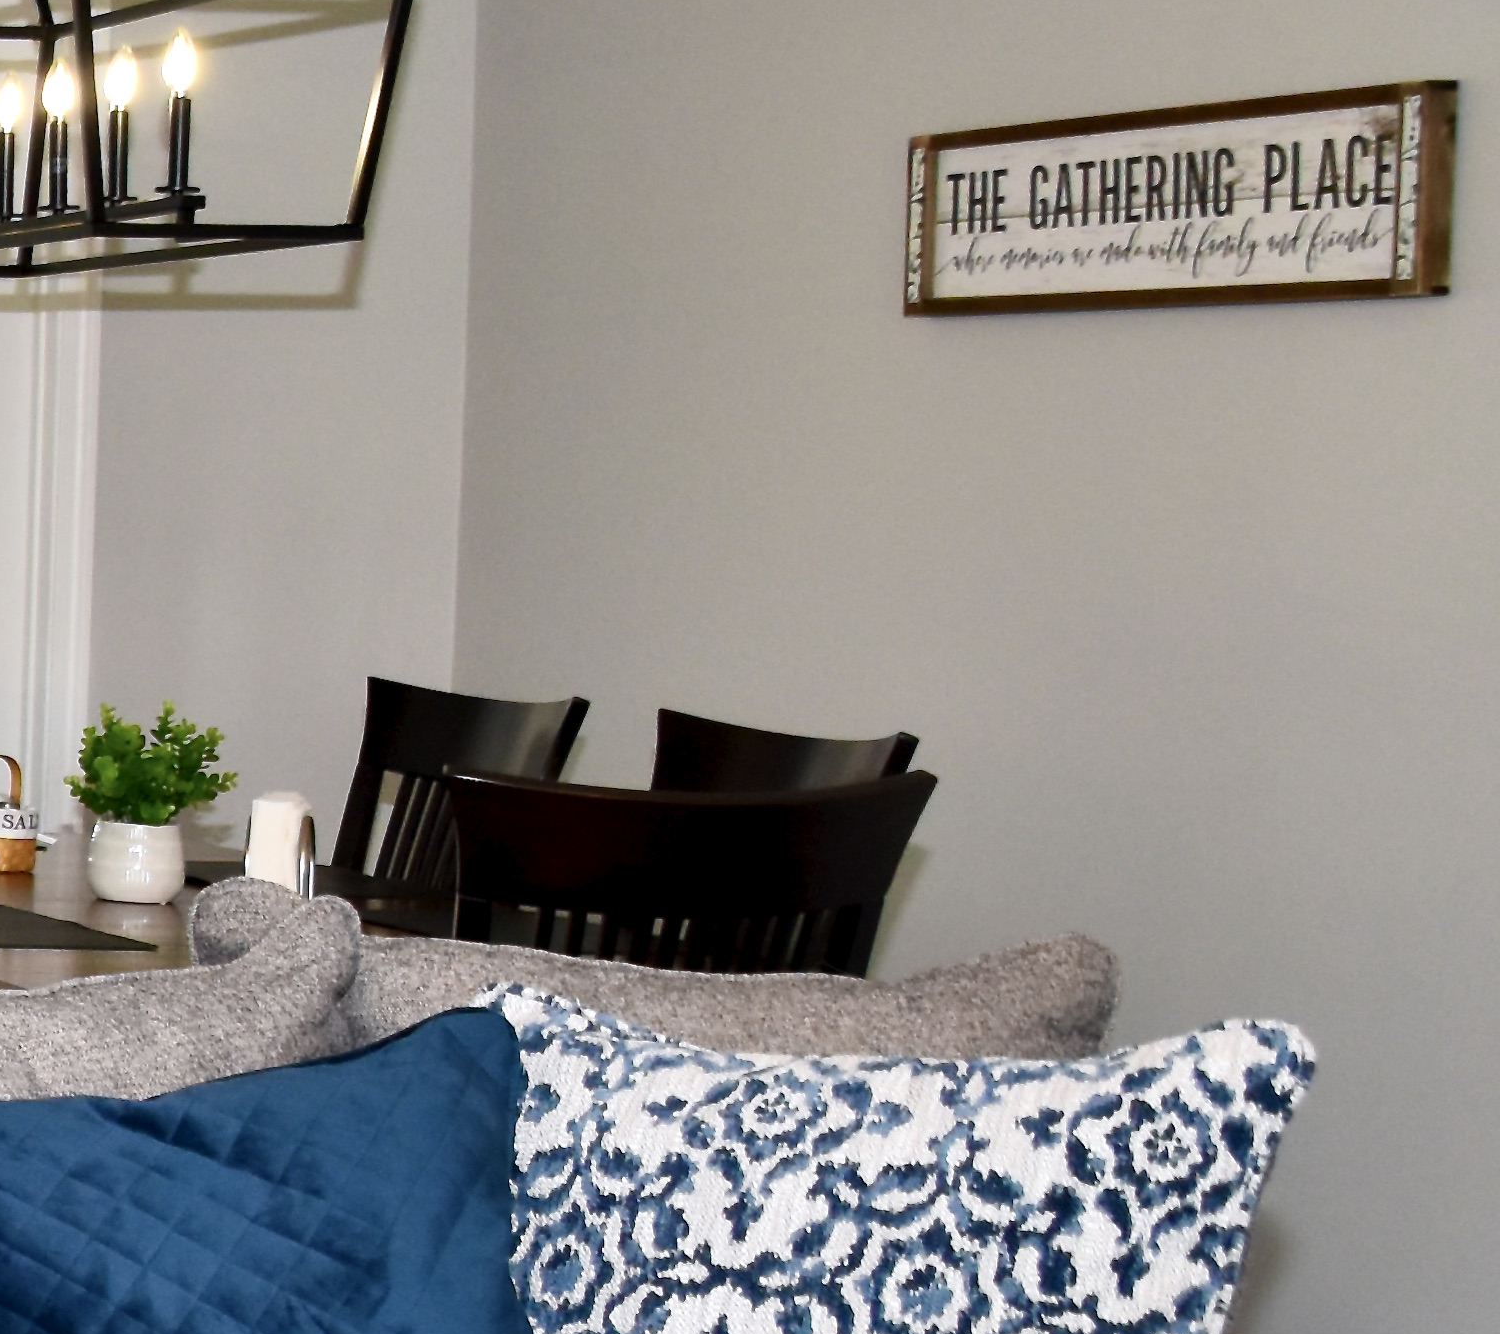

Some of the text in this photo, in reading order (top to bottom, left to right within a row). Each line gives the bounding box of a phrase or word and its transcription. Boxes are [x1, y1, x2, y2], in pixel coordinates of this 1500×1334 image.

[946, 135, 1394, 236] THE GATHERING PLACE
[1147, 221, 1193, 265] with
[1192, 220, 1258, 279] family
[1305, 208, 1386, 274] friends
